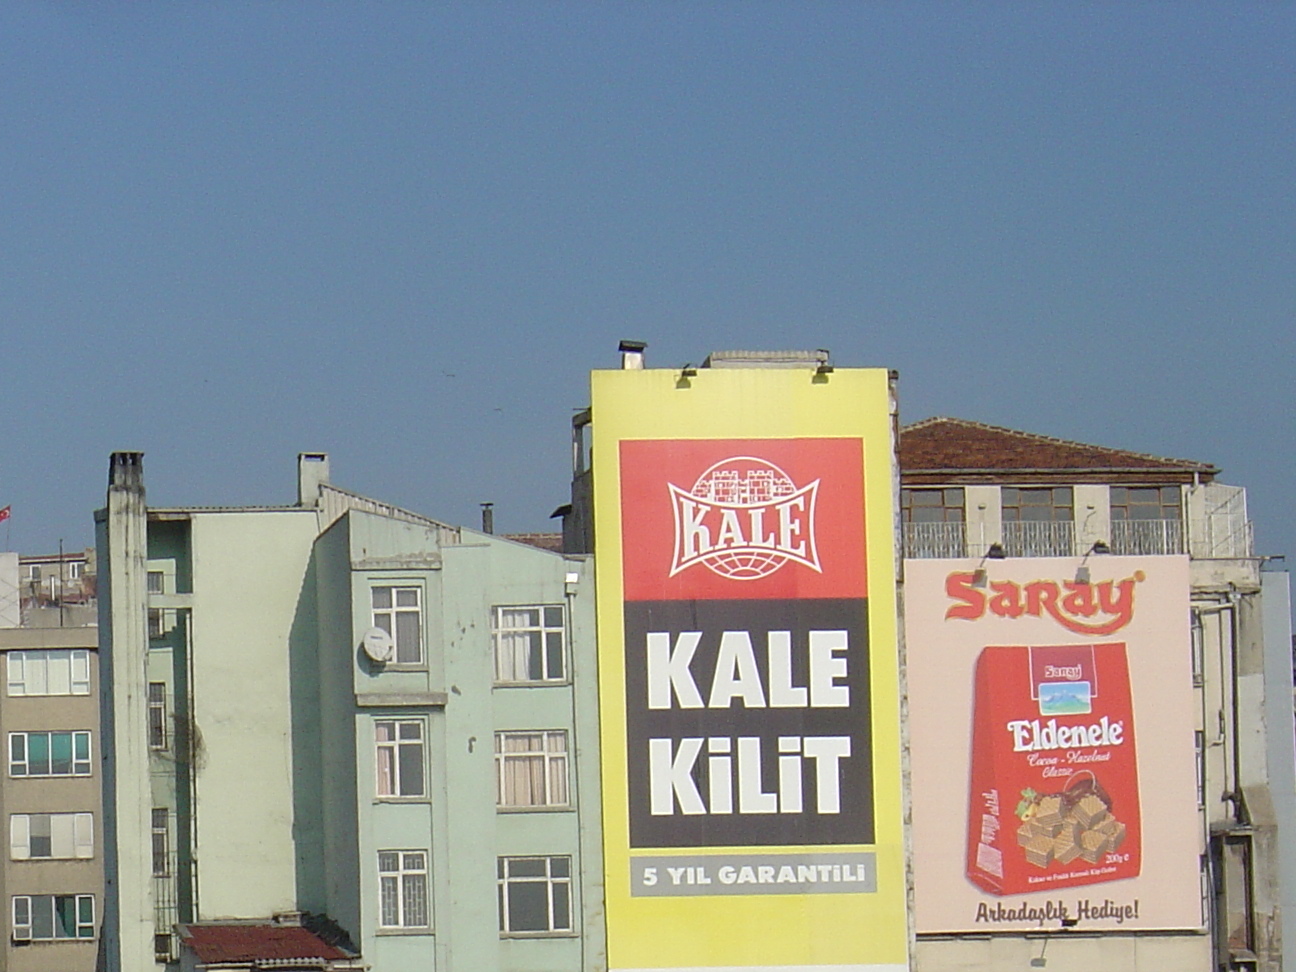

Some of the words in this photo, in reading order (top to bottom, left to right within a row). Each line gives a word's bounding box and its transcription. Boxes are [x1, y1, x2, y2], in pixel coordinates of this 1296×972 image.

[680, 497, 807, 562] KALE
[945, 570, 1146, 637] Saray
[646, 630, 851, 710] KALE
[1007, 716, 1124, 752] Eldenele
[643, 868, 658, 886] 5
[667, 868, 712, 886] YIL
[975, 900, 1070, 926] Arkadaşlık
[1077, 899, 1139, 924] Hediye!
